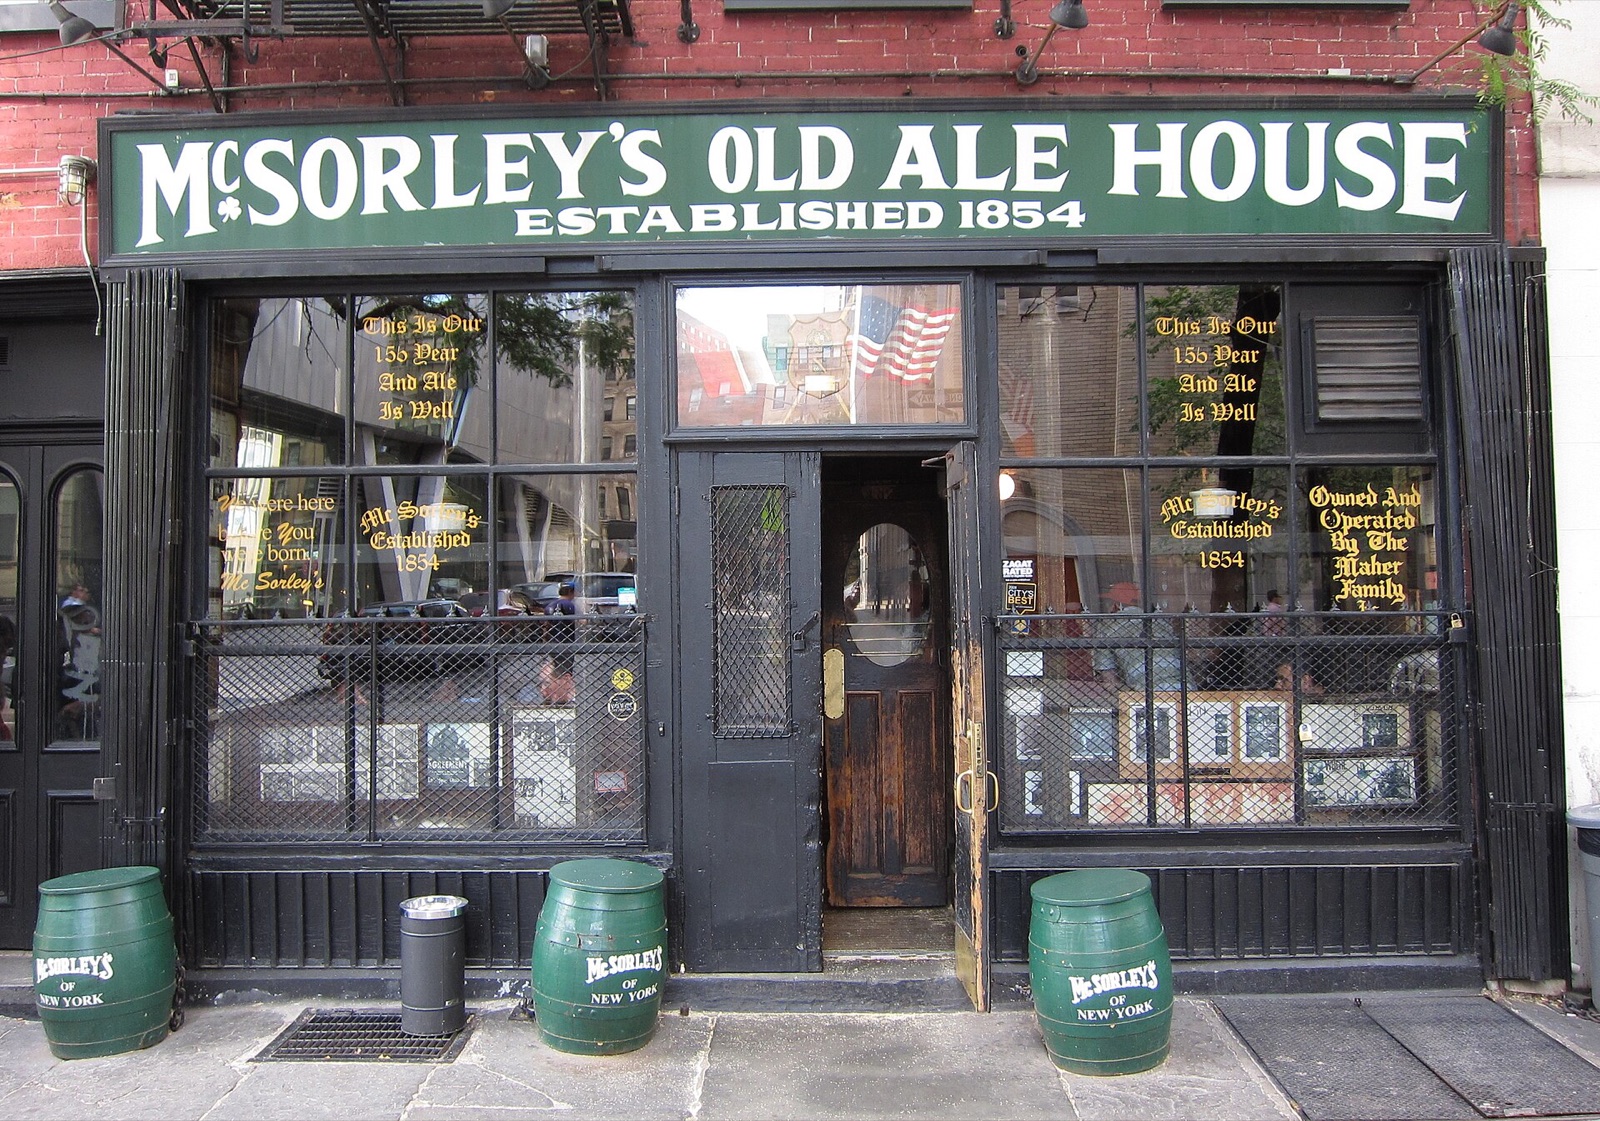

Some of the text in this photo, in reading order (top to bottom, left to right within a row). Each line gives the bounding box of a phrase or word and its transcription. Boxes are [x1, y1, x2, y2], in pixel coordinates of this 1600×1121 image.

[707, 125, 855, 193] OLD
[878, 122, 1070, 193] ALE
[1107, 119, 1469, 221] HOUSE
[514, 199, 1086, 237] ESTABLISHED 1854
[363, 313, 483, 338] This Is Our
[1155, 316, 1277, 339] This Is Our
[375, 343, 459, 366] 156 Year
[1174, 344, 1260, 368] 156 Year
[378, 371, 457, 392] And Ale
[1179, 373, 1257, 393] And Ale
[378, 400, 454, 420] Is Well
[1180, 402, 1256, 422] Is Well
[297, 493, 335, 511] here
[1160, 489, 1282, 523] Mc Sorley's
[1309, 482, 1421, 508] Owned And
[360, 506, 394, 535] Mc
[1171, 520, 1272, 542] Established
[1320, 508, 1416, 536] Operated
[277, 522, 315, 546] You
[370, 530, 471, 552] Established
[1328, 530, 1409, 557] By The
[396, 553, 441, 572] 1854
[1002, 560, 1033, 568] ZAGAT
[1200, 550, 1245, 569] 1854
[1332, 553, 1404, 581] Maher
[221, 570, 325, 594] Mc Sorley's
[1002, 567, 1033, 575] RATED
[1008, 589, 1034, 598] CITY'S
[1008, 596, 1033, 605] BEST
[1335, 577, 1406, 605] Family
[60, 982, 76, 992] OF
[591, 983, 658, 1005] NEW YORK
[622, 979, 639, 990] OF
[40, 993, 104, 1007] NEW YORK
[1077, 999, 1154, 1021] NEW YORK
[1109, 994, 1127, 1007] OF
